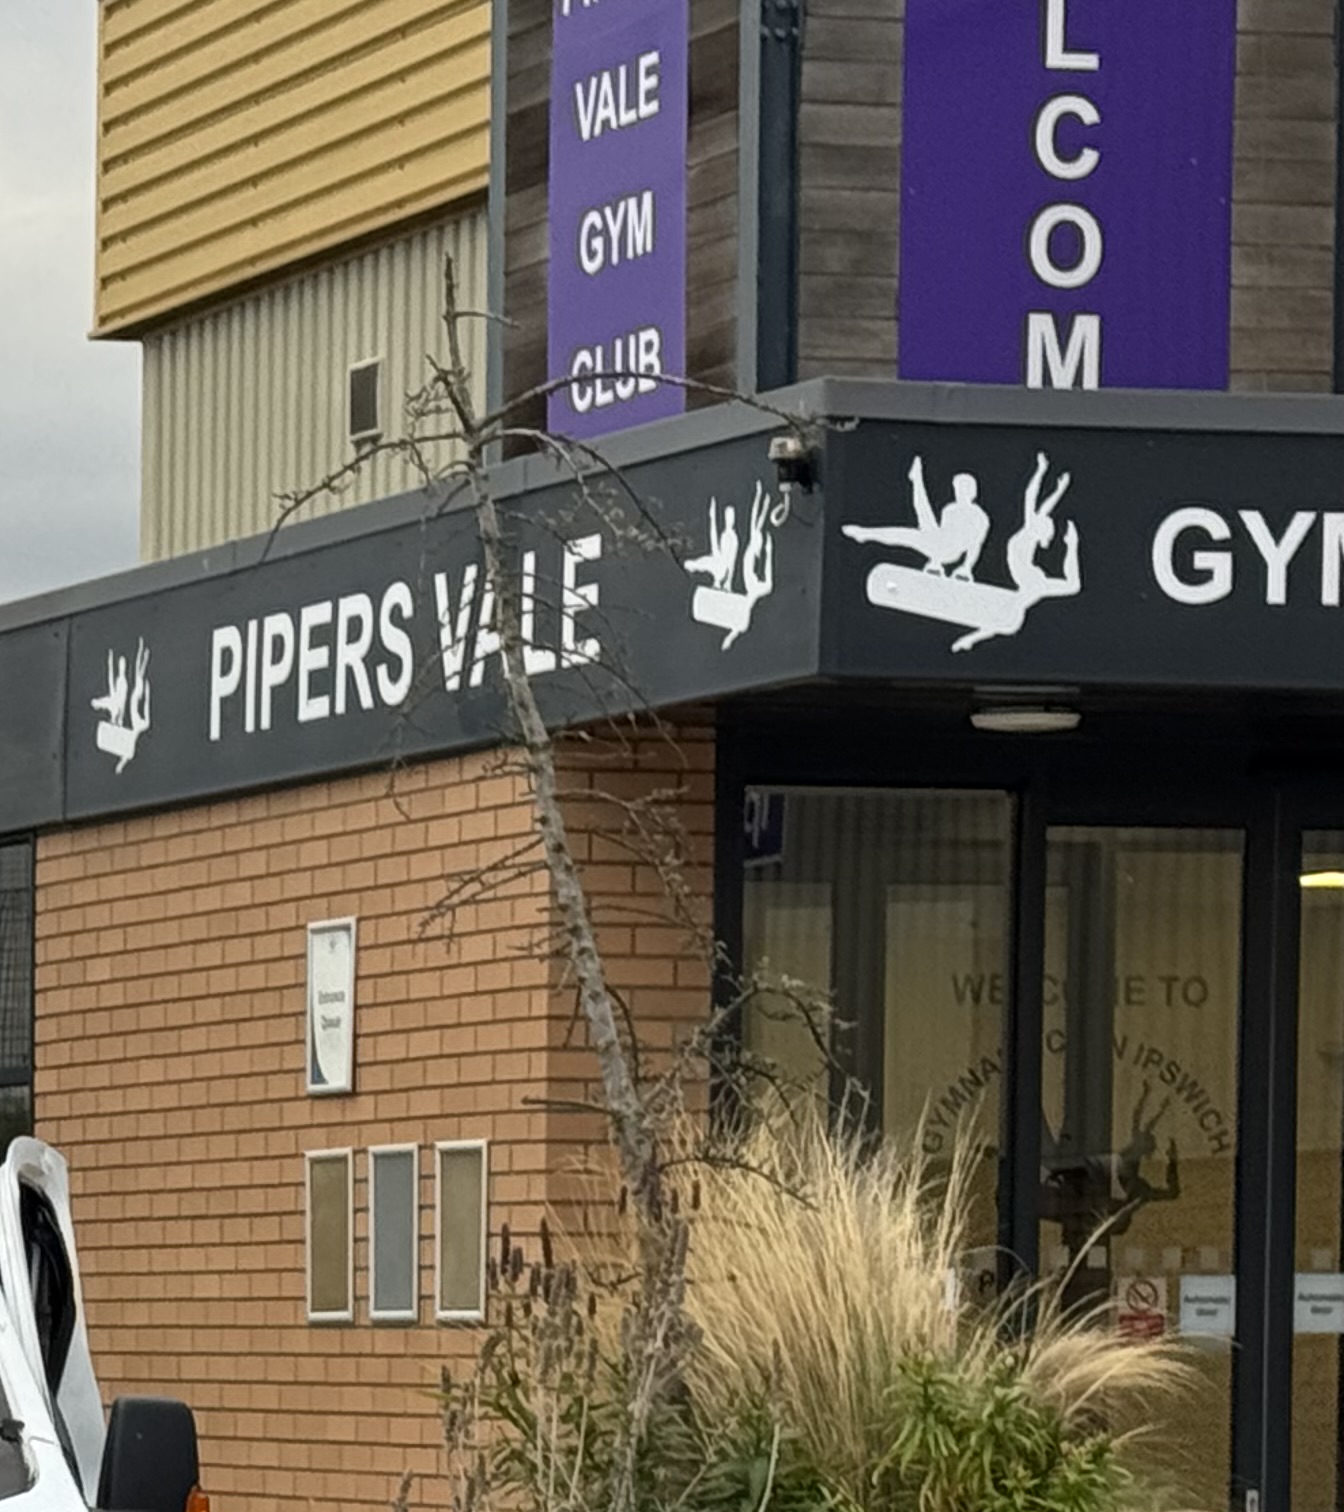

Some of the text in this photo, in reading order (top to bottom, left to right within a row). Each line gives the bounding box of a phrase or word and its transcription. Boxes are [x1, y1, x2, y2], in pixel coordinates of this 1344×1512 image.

[575, 50, 660, 142] VALE
[579, 190, 653, 276] GYM
[570, 327, 661, 413] CLUB
[209, 533, 603, 741] PIPERS VALE
[1159, 975, 1209, 1007] TO
[1133, 1042, 1231, 1155] IPSWICH
